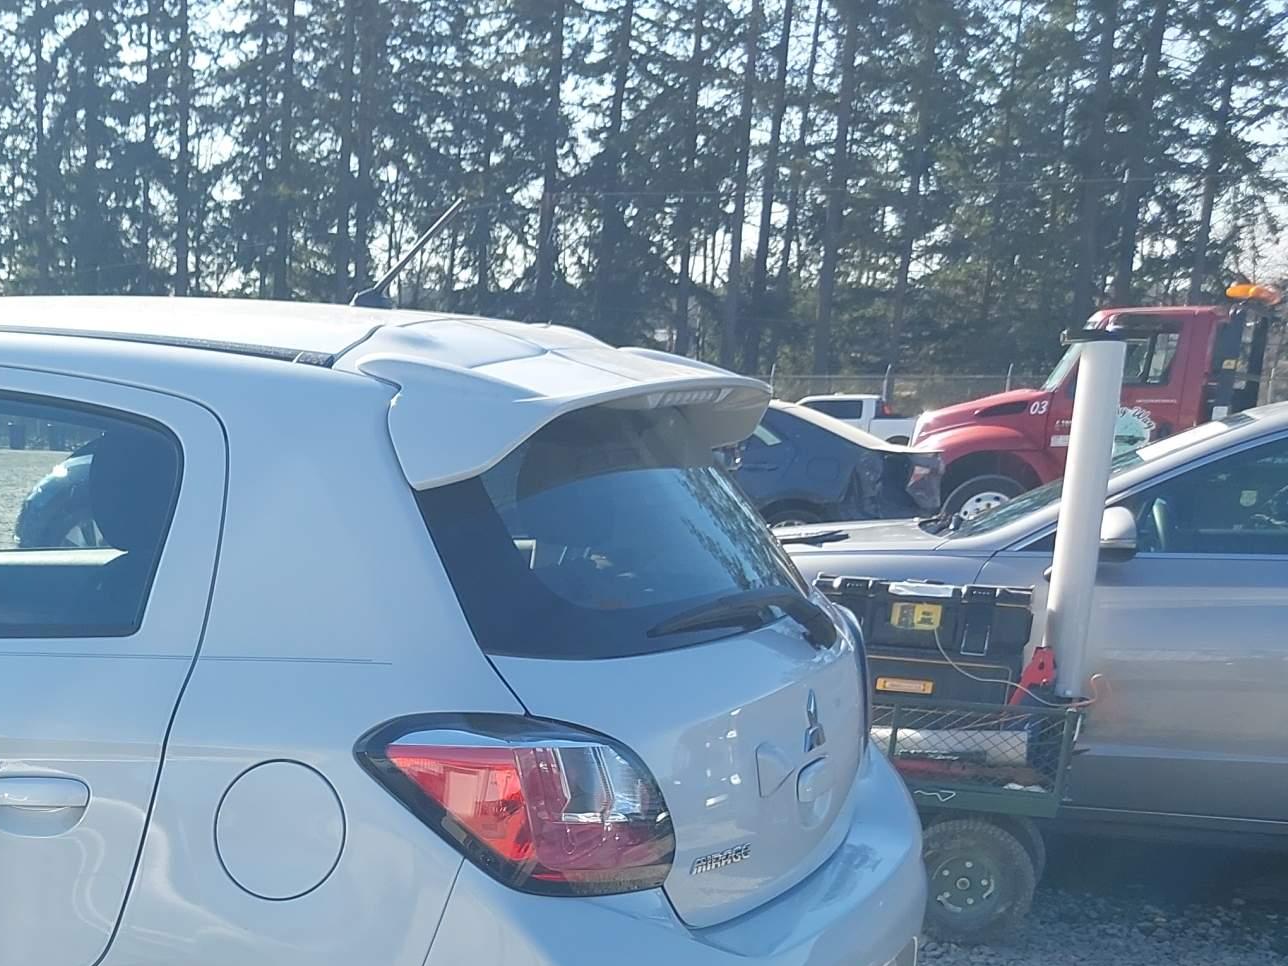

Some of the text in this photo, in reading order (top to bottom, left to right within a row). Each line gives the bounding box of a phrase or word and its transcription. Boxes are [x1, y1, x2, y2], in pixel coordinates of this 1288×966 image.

[1029, 401, 1049, 415] 03
[1132, 407, 1154, 429] Way
[689, 842, 753, 875] MIRAGE
